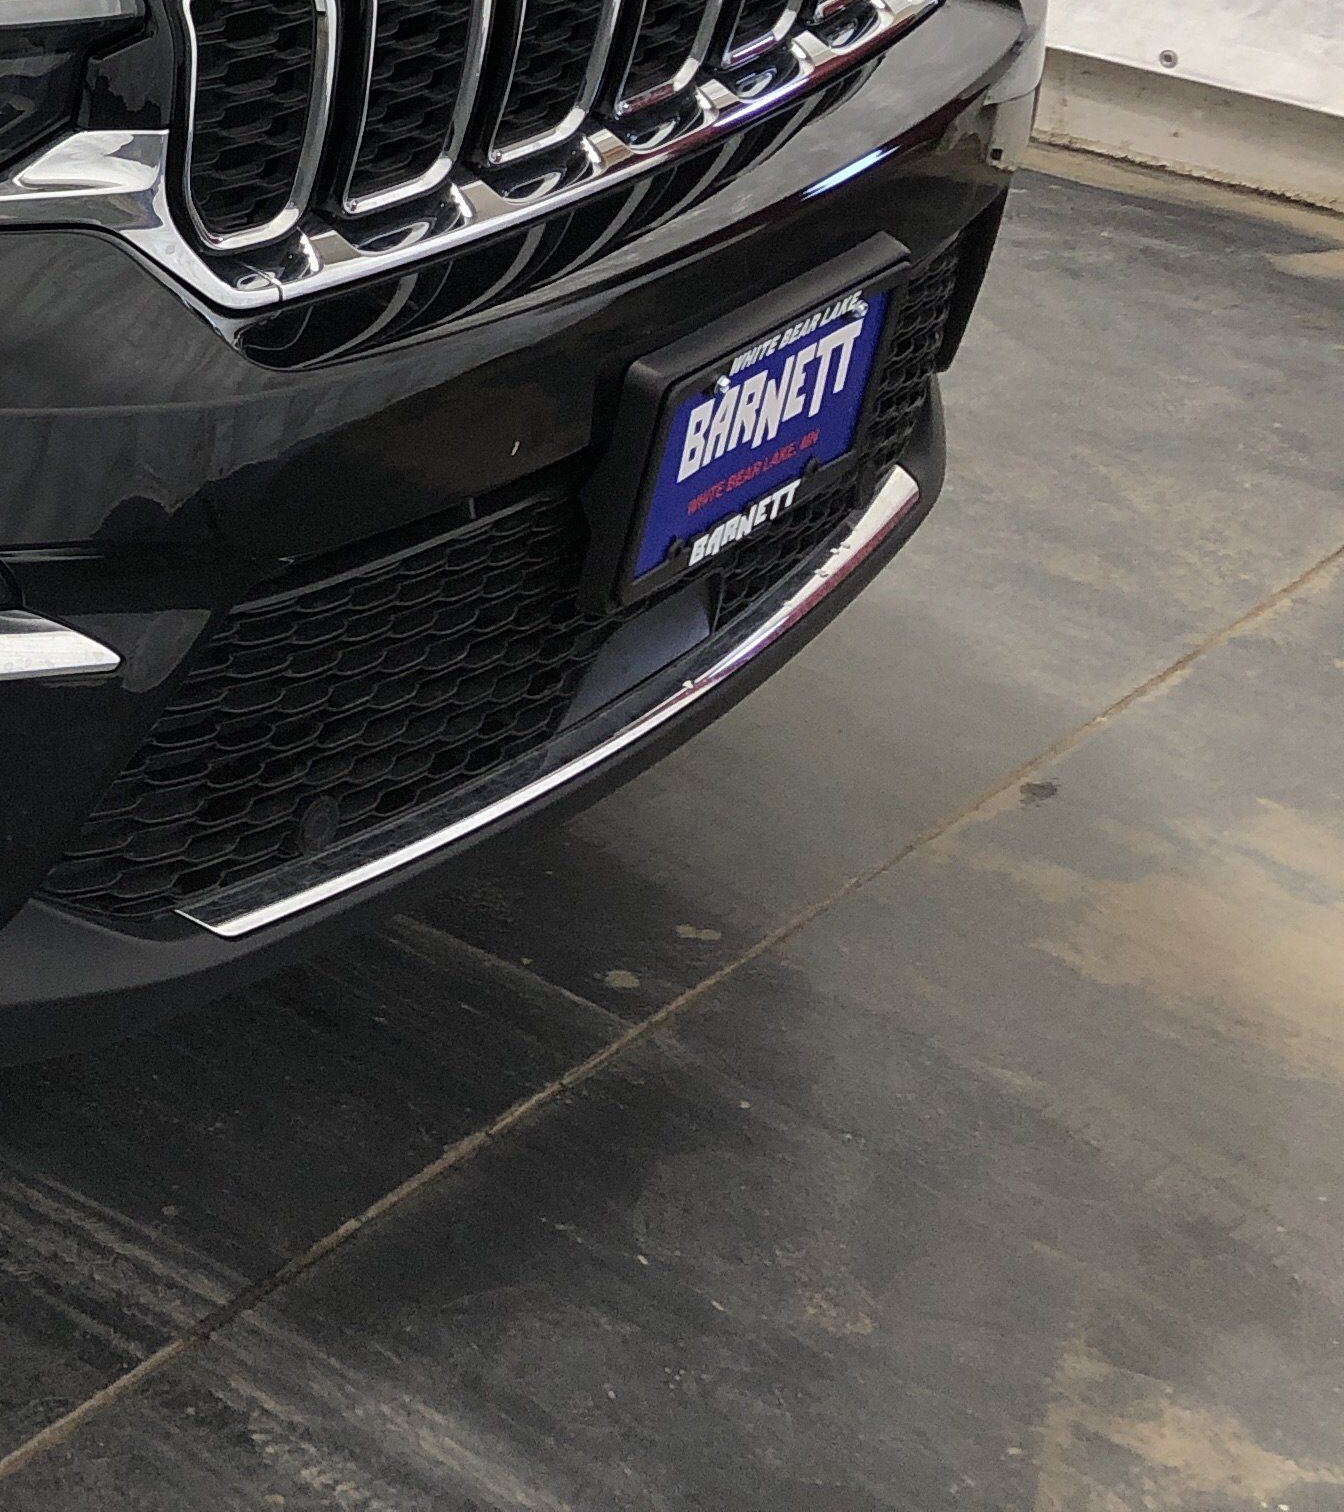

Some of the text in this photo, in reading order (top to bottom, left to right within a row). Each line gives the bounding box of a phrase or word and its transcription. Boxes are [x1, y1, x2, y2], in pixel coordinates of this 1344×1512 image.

[729, 334, 781, 376] WHITE
[778, 313, 821, 350] BEAR
[676, 318, 864, 484] BARNETT
[688, 478, 802, 567] BARNETT
